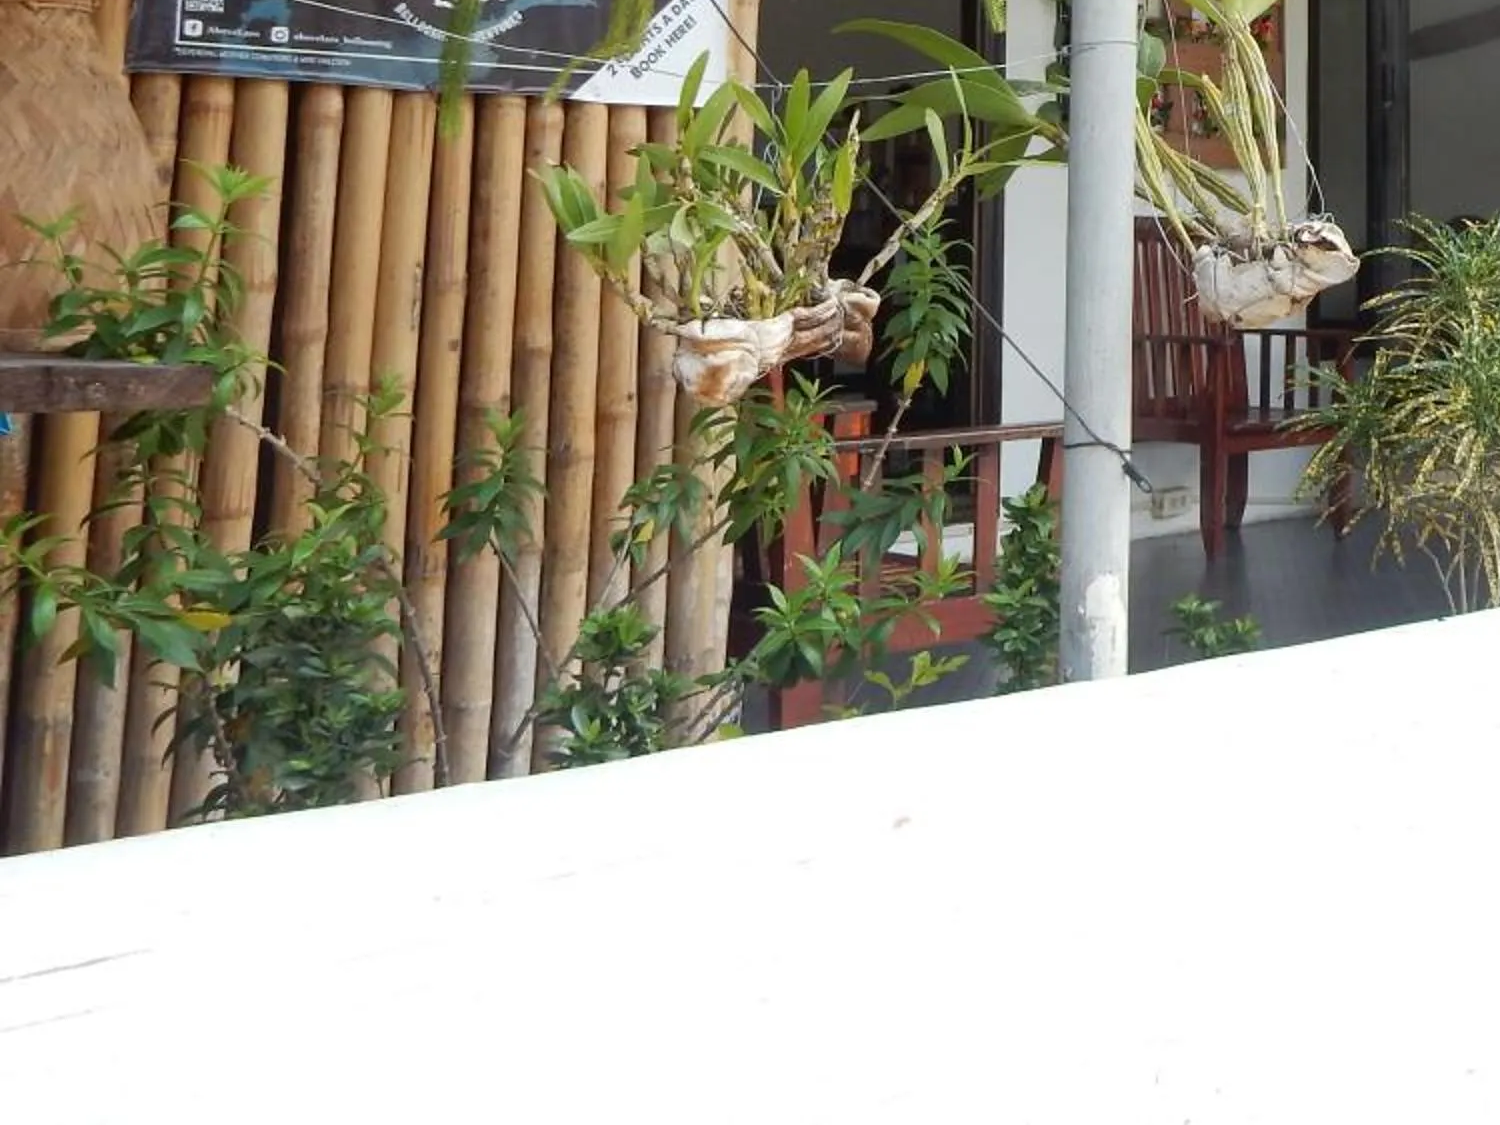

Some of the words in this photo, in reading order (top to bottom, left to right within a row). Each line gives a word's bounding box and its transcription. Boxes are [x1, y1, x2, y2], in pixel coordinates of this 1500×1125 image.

[662, 15, 674, 27] A
[629, 45, 667, 79] BOOK
[664, 14, 698, 49] HERE!
